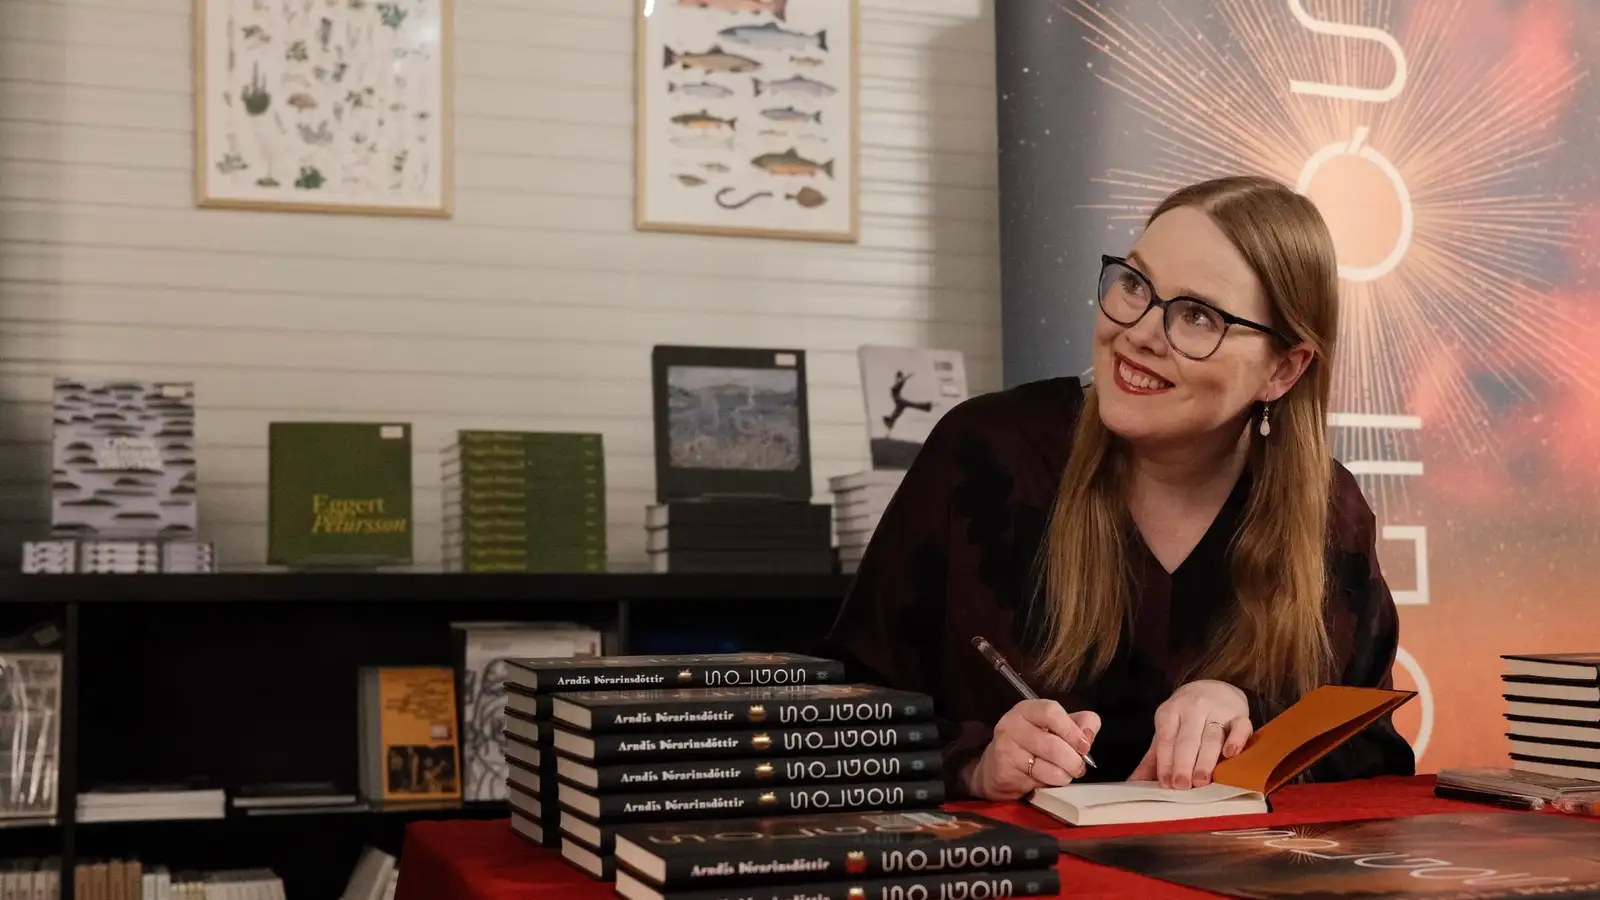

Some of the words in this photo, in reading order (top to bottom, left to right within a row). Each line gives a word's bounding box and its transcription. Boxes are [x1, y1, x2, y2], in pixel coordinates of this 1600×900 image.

[313, 493, 385, 516] Eggert
[557, 675, 591, 686] Arndís
[614, 712, 652, 724] Arndís
[617, 739, 656, 752] Arndís
[620, 770, 658, 783] Arndís
[623, 800, 661, 813] Arndís
